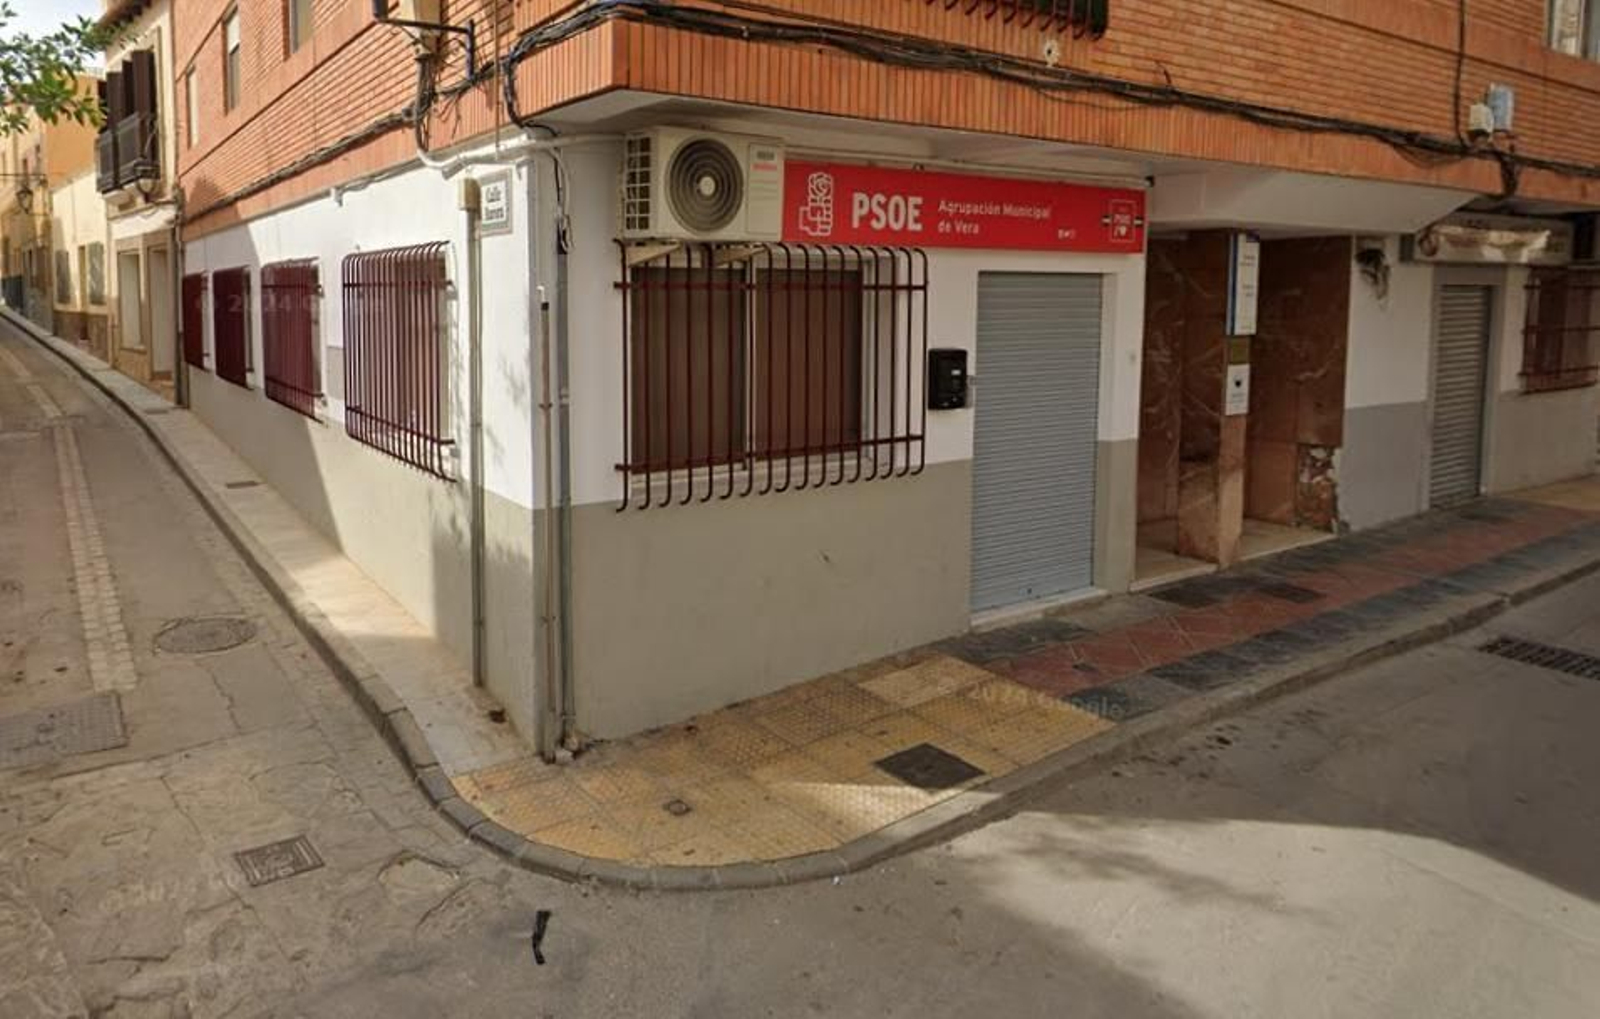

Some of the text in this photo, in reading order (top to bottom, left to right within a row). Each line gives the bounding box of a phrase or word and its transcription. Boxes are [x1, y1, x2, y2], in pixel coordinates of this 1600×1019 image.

[852, 192, 923, 231] PSOE
[938, 200, 1051, 219] Agrupación Municipal
[938, 221, 979, 234] de Vera
